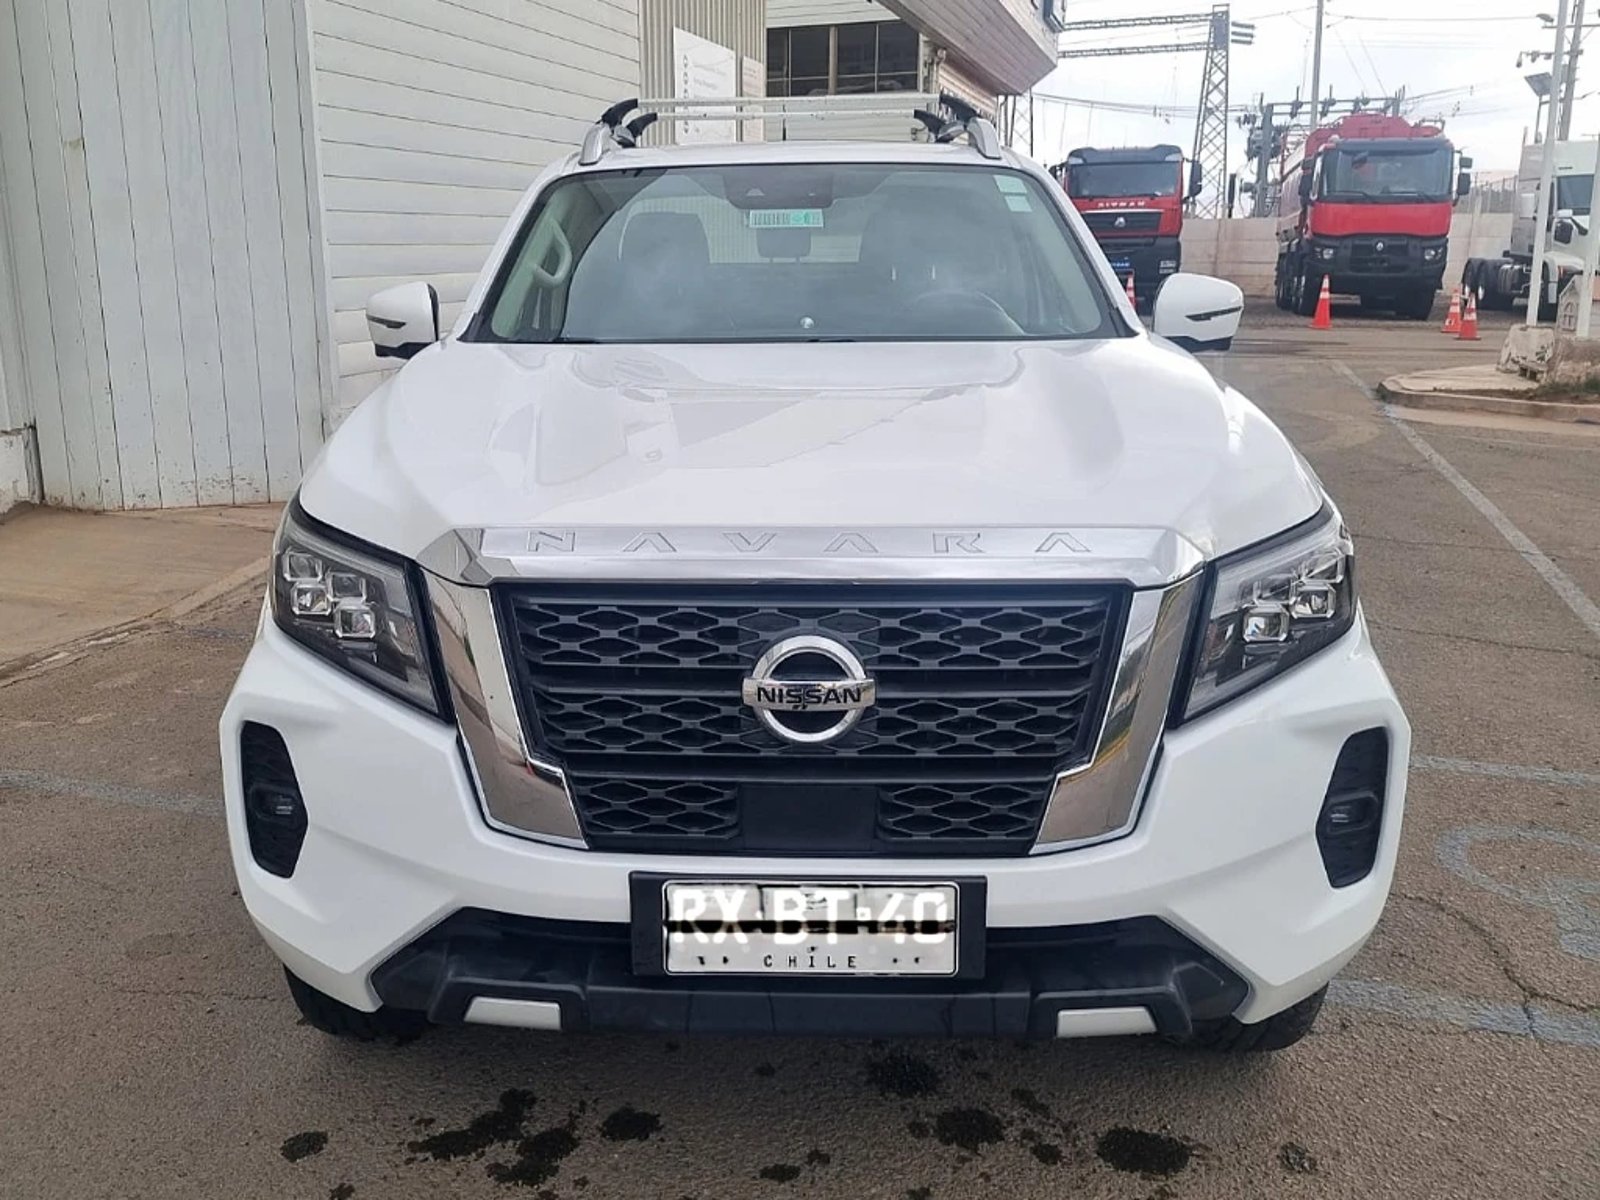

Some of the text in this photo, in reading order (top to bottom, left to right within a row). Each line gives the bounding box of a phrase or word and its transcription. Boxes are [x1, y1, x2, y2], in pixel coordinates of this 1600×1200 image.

[527, 531, 1092, 554] NAVARA
[757, 686, 861, 705] NISSAN
[763, 955, 857, 969] CHILE
